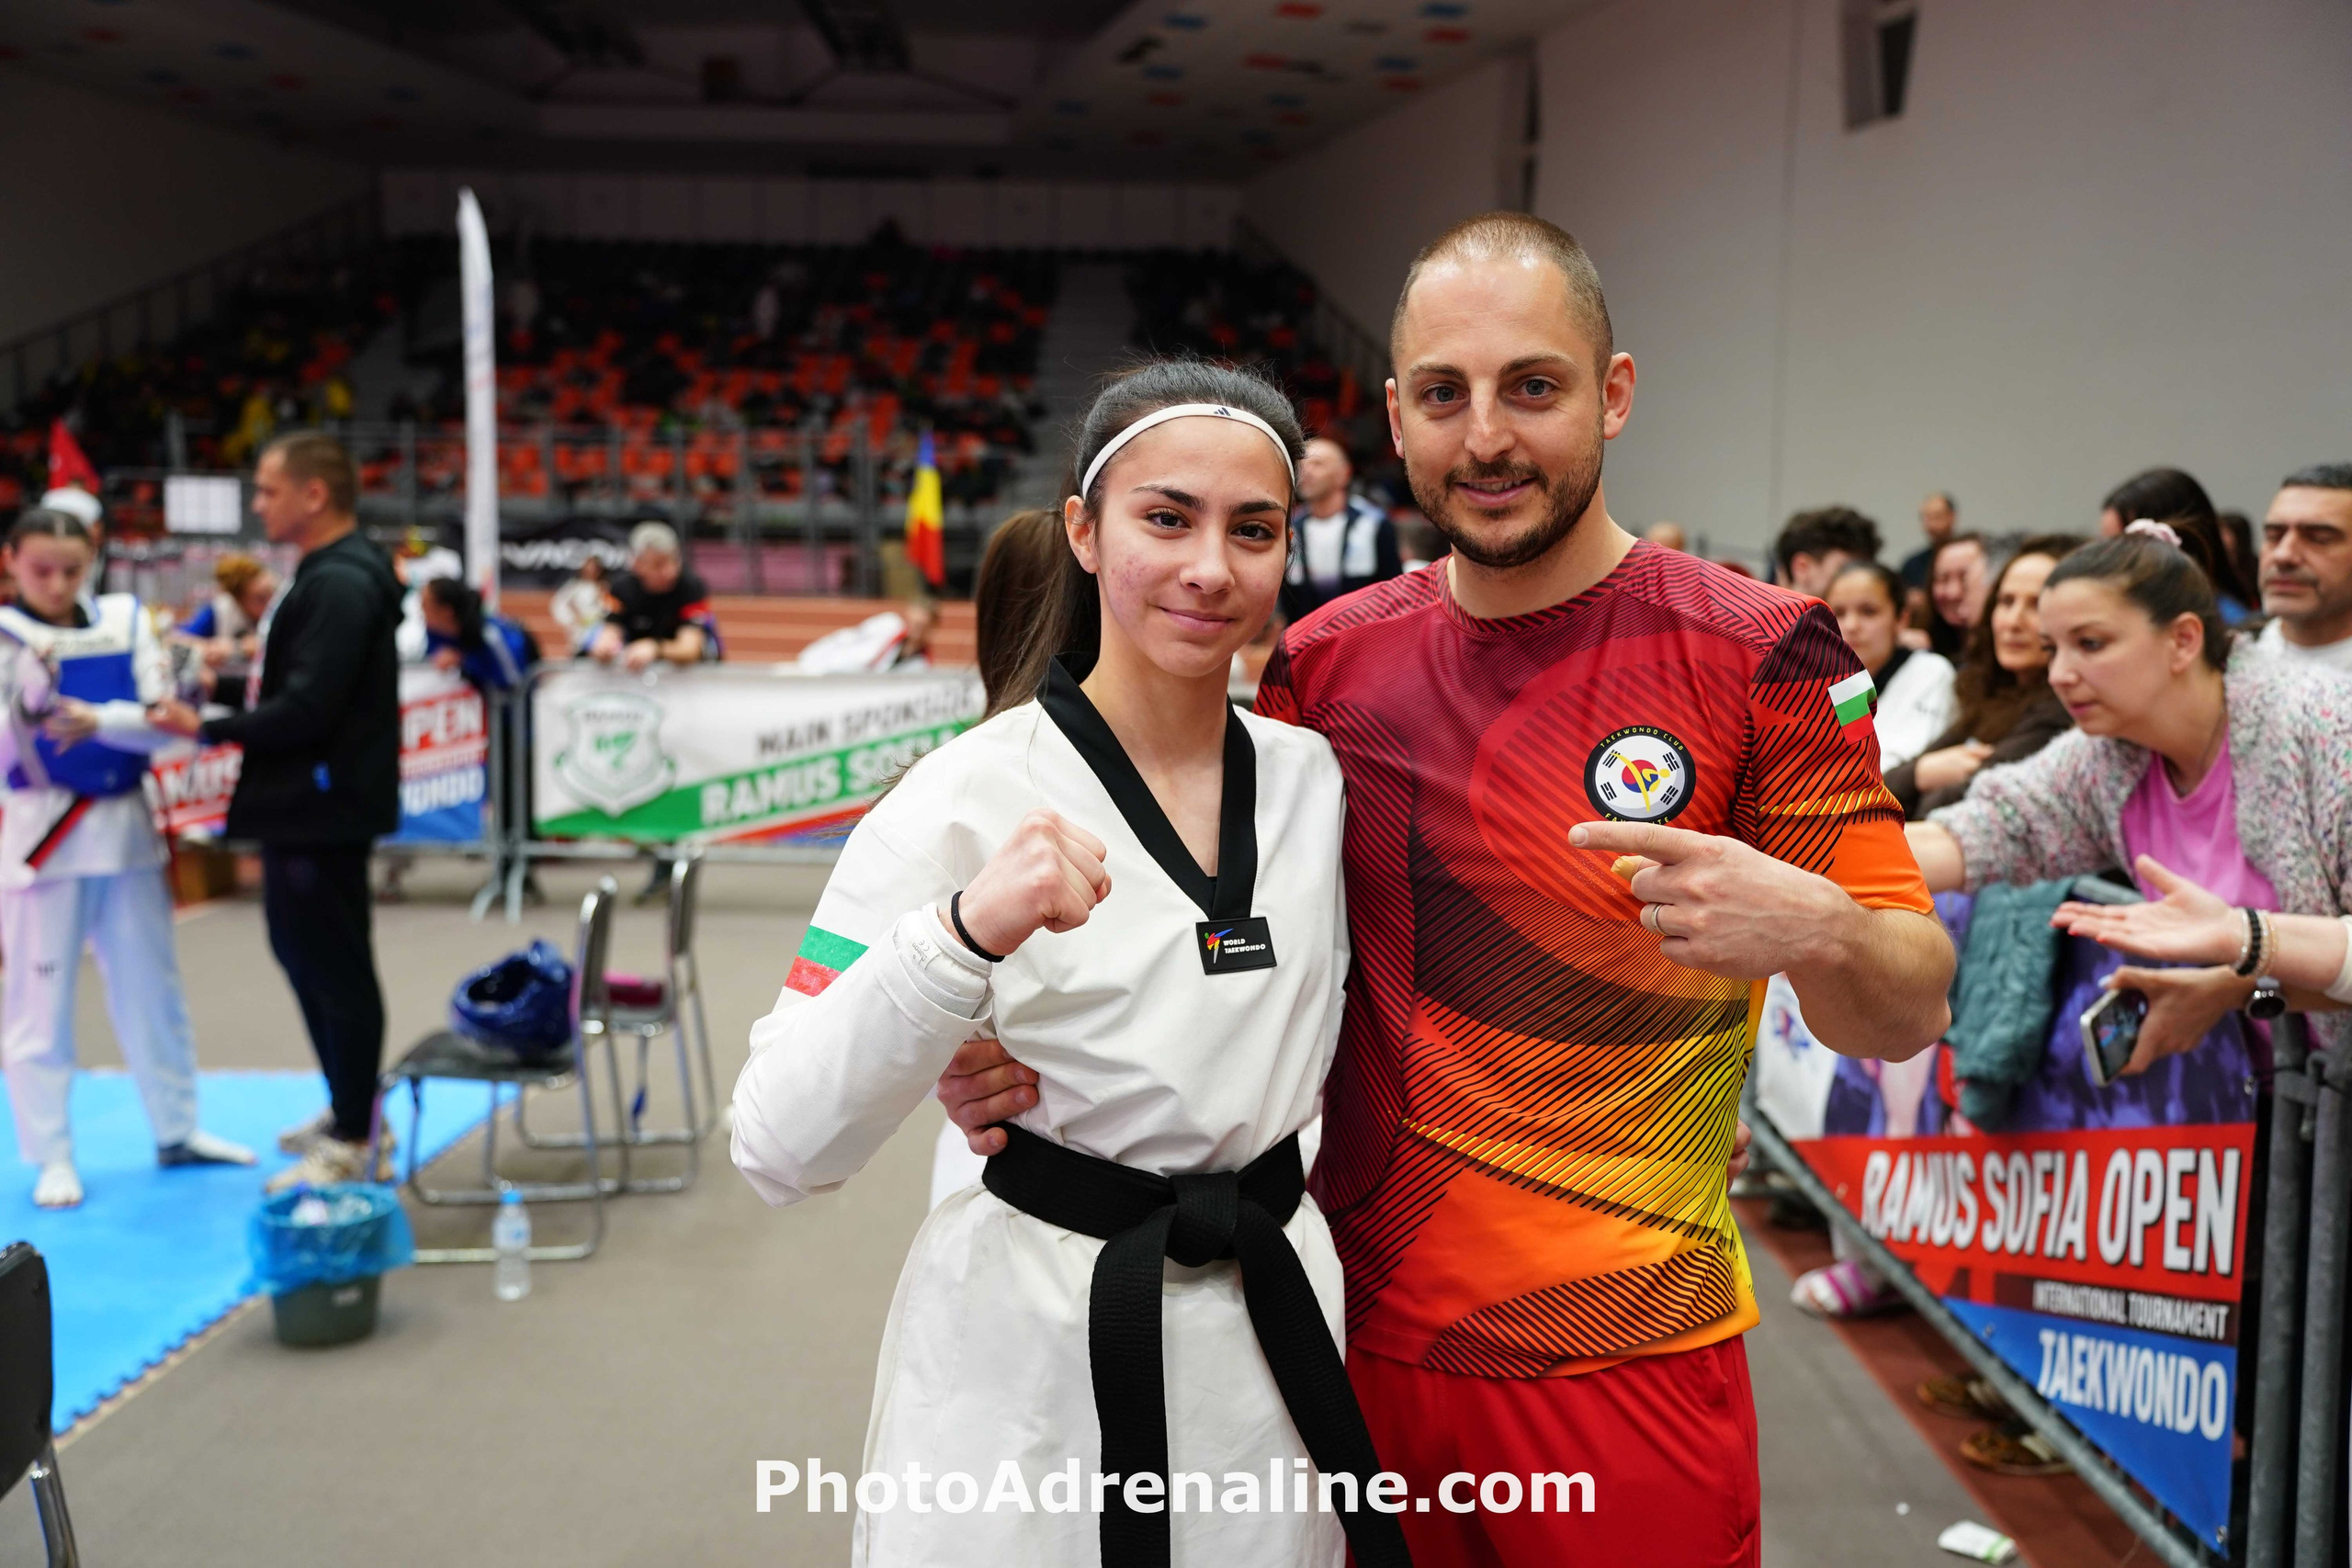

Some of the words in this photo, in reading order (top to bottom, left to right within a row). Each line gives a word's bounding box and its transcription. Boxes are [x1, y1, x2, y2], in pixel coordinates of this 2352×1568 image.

[1600, 727, 1658, 748] TAEKWONDO
[1663, 733, 1684, 751] CLUB
[699, 755, 842, 826] RAMUS
[1225, 944, 1266, 954] TAEKWONDO
[1861, 1149, 1979, 1250] RAMUS
[1981, 1149, 2089, 1261] SOFIA
[2097, 1147, 2241, 1276] OPEN
[2032, 1279, 2127, 1325] INTERNATIONAL
[2128, 1292, 2230, 1341] TOURNAMENT
[2036, 1328, 2229, 1442] TAEKWONDO
